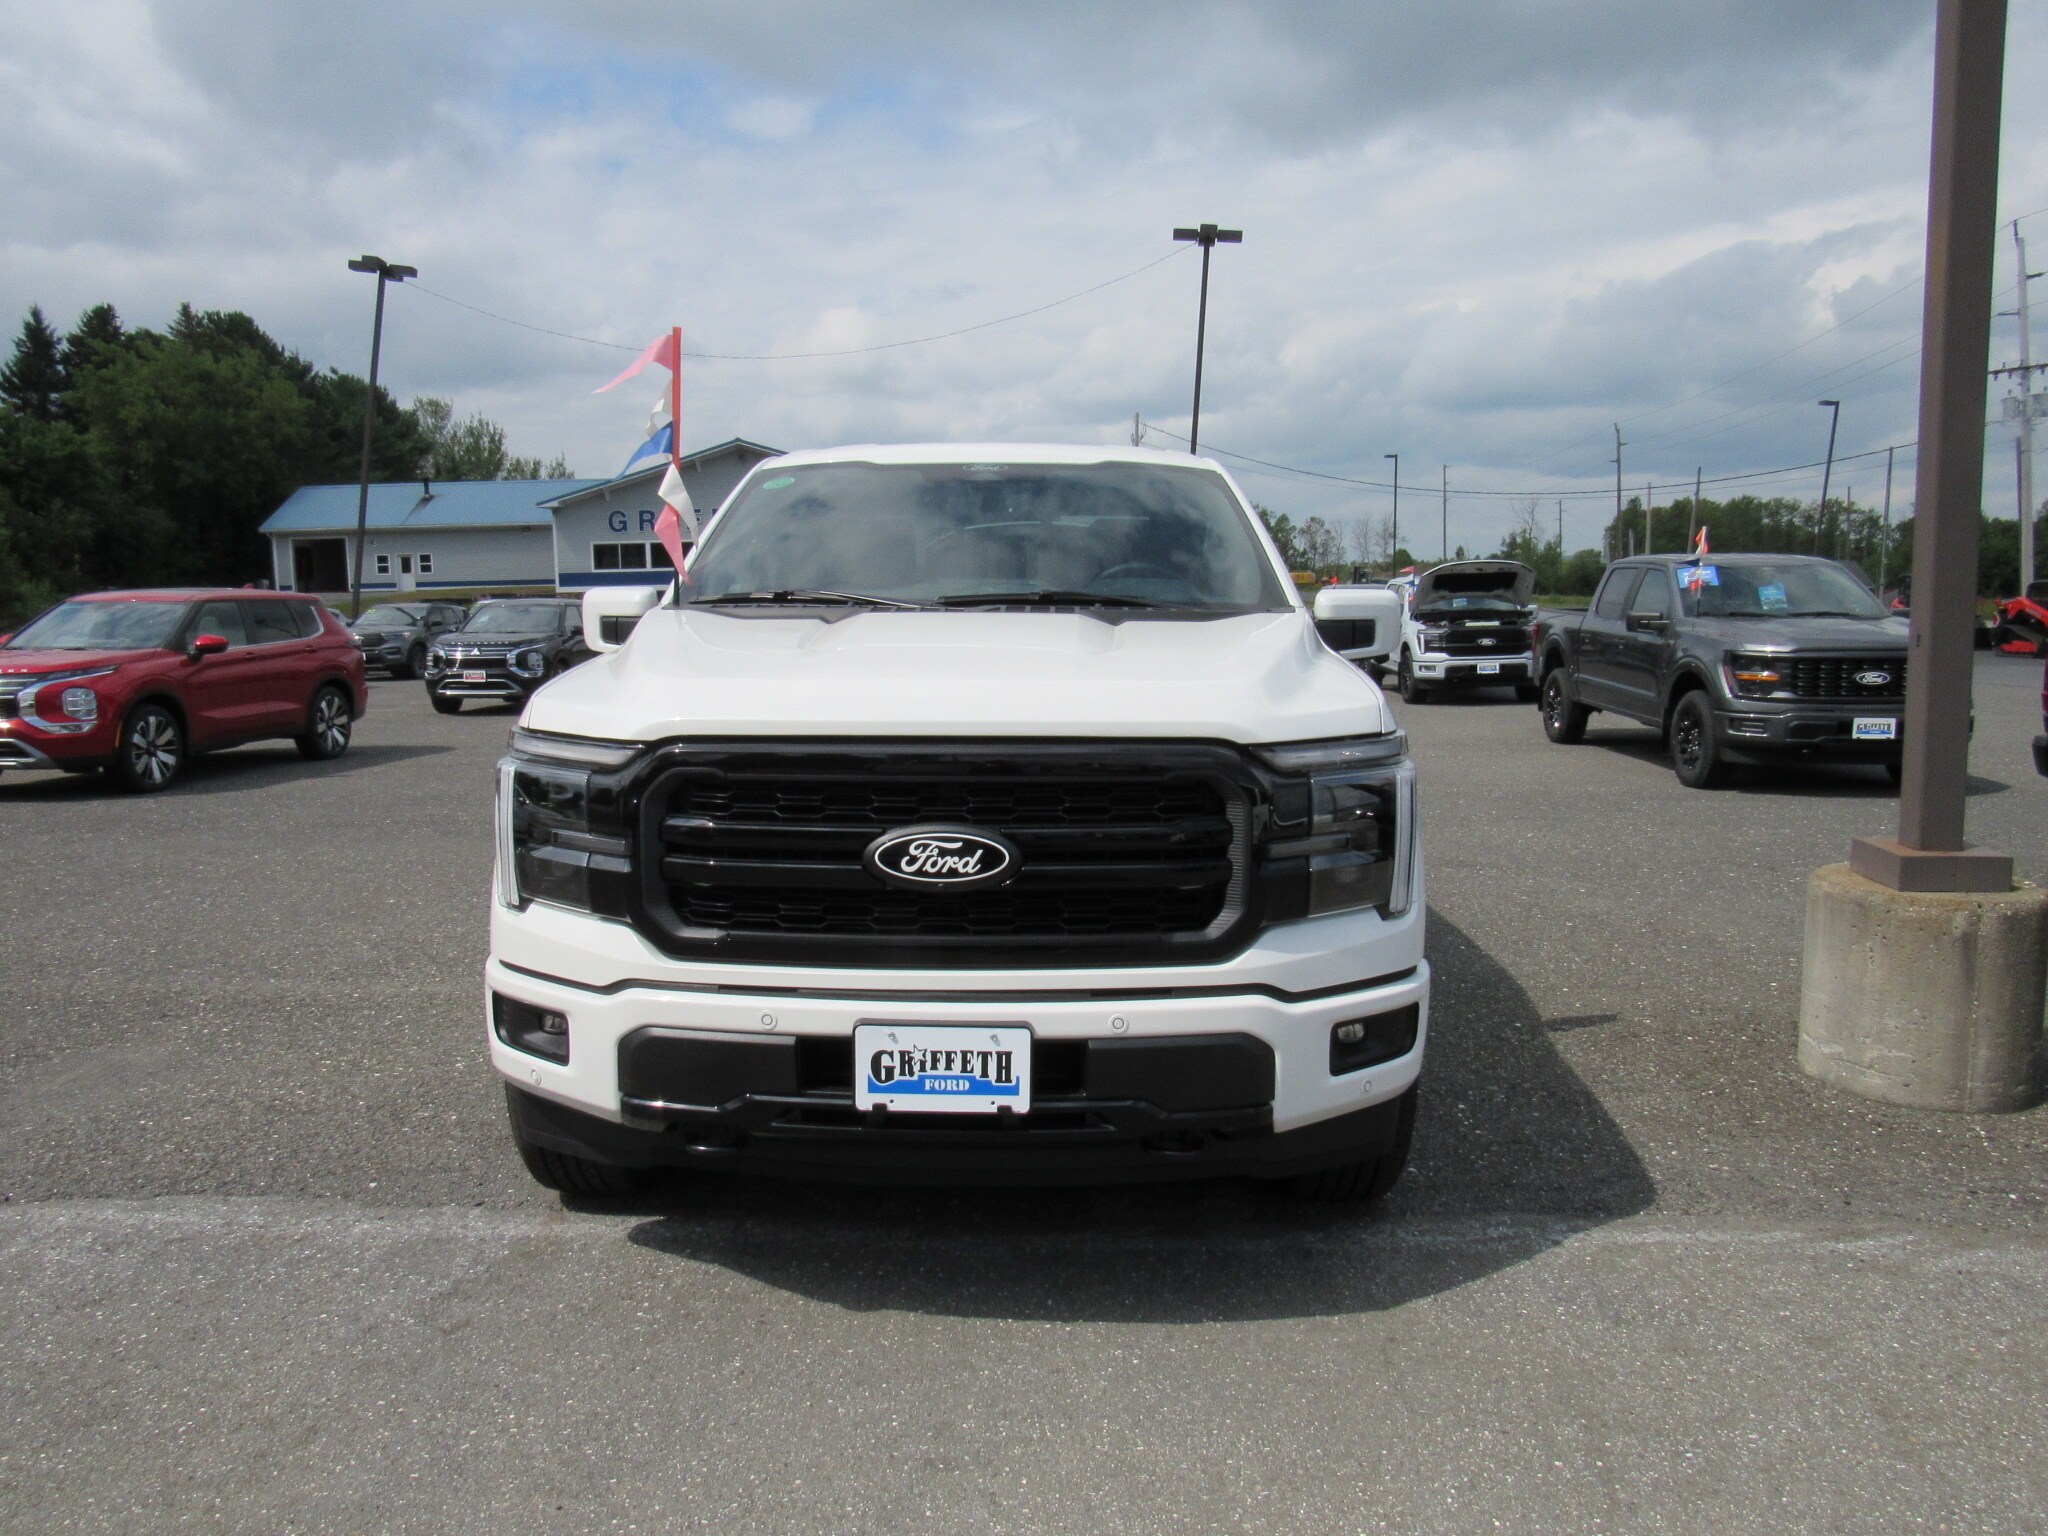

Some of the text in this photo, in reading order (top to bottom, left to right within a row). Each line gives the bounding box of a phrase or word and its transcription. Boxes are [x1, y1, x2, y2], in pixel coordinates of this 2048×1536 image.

[900, 840, 983, 874] Ford
[870, 1044, 1013, 1084] GRIFFETH
[924, 1078, 970, 1091] FORD
